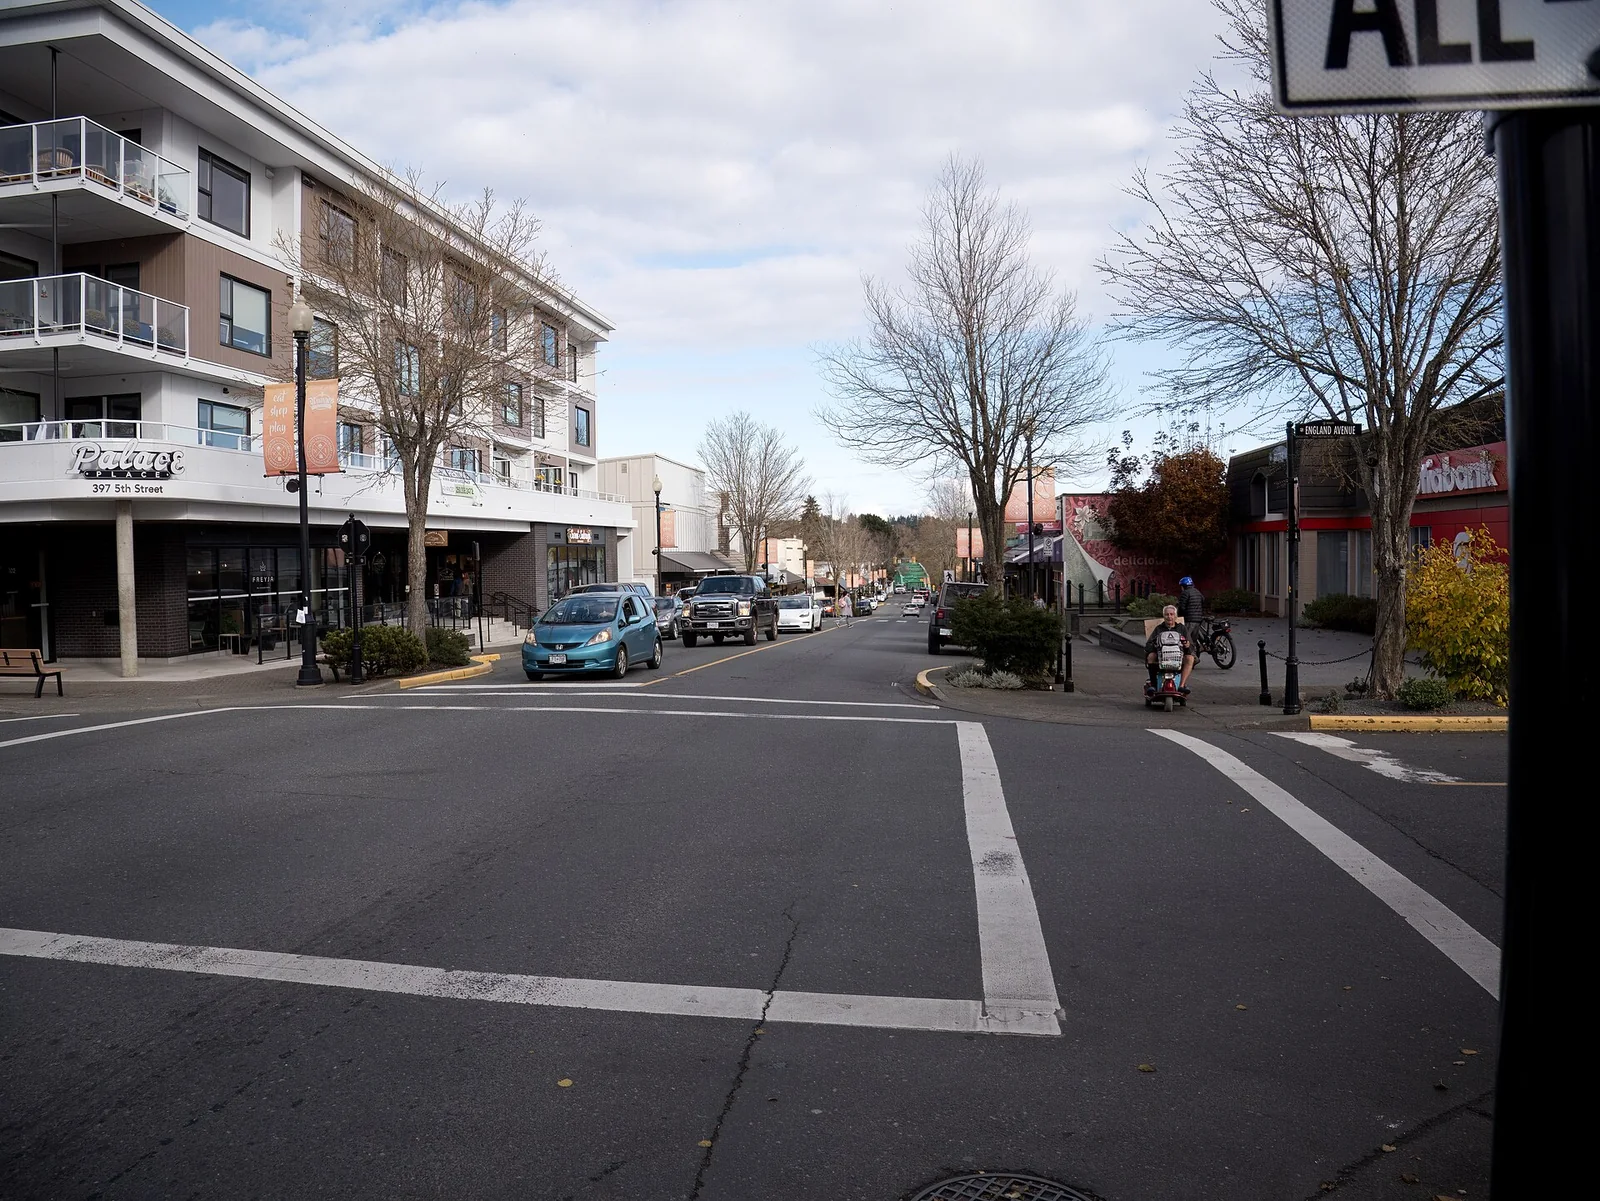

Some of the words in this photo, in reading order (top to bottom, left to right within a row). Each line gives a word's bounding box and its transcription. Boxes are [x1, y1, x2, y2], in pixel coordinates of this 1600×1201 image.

[273, 390, 287, 403] eat
[270, 405, 288, 418] shop
[269, 421, 287, 436] play
[1305, 425, 1332, 435] ENGLAND
[1333, 425, 1356, 435] AVENUE
[92, 483, 111, 494] 397
[114, 483, 131, 494] 5th
[134, 483, 164, 494] Street
